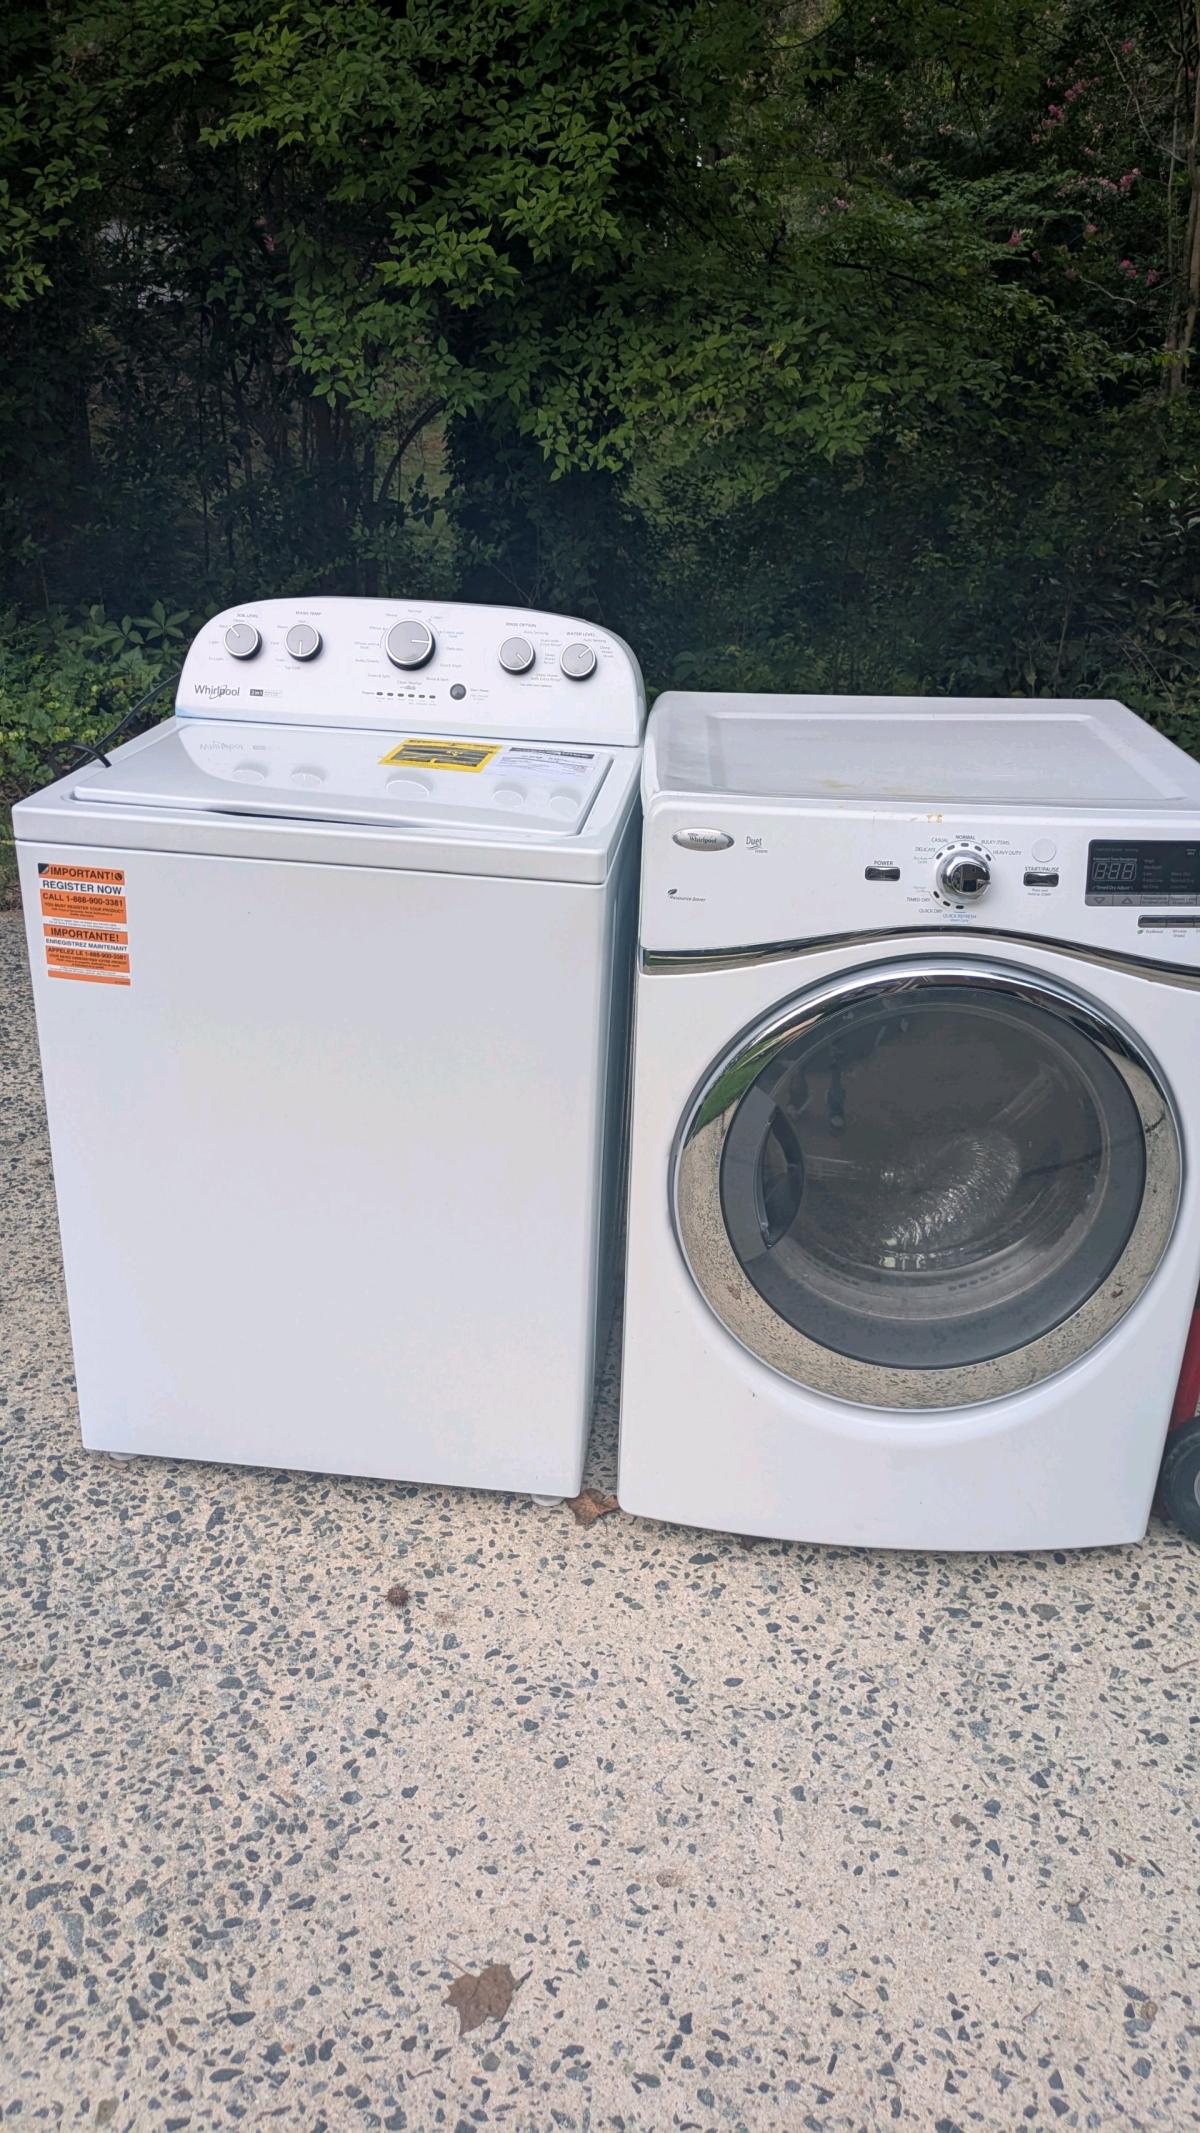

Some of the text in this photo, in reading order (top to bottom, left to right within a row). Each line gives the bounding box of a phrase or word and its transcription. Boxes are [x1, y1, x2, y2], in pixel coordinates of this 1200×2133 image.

[194, 684, 240, 700] Whirlpool
[689, 835, 717, 845] Whirlpool
[745, 836, 763, 846] Duet
[50, 867, 114, 880] IMPORTANT!
[43, 880, 122, 895] REGISTER NOW
[42, 892, 123, 907] CALL 1-888-900-3381
[51, 927, 119, 942] IMPORTANTE!
[46, 938, 128, 952] ENREGISTREZ MAINTENANT
[48, 946, 74, 955] APPELEZ
